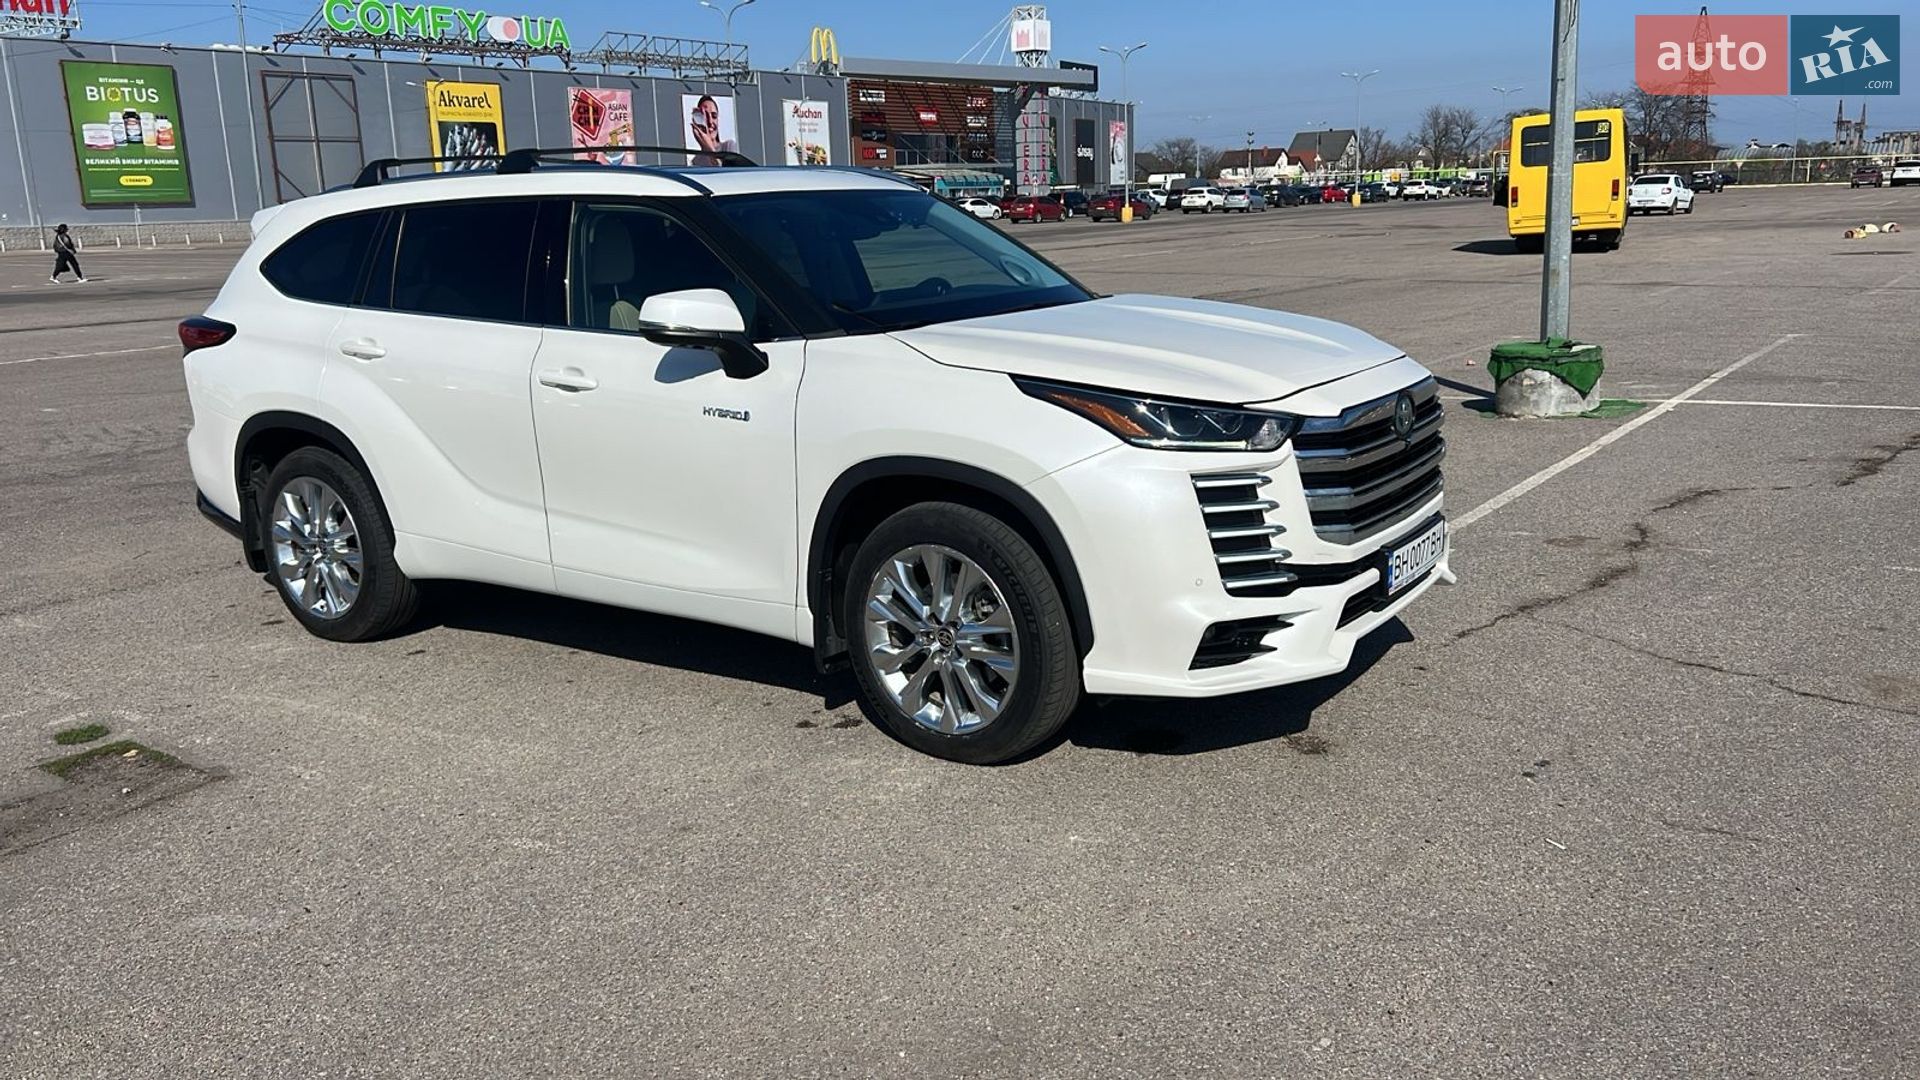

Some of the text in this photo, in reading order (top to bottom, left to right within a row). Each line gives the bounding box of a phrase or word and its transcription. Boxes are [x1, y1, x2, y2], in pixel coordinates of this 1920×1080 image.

[323, 0, 570, 49] COMFY UA
[85, 86, 160, 103] BIOTUS
[439, 90, 492, 109] Akvarel
[608, 103, 628, 112] ASIAN
[792, 105, 822, 119] Auchan
[608, 112, 629, 122] CAFE
[703, 406, 742, 420] HYBRID
[1410, 536, 1430, 570] 0077
